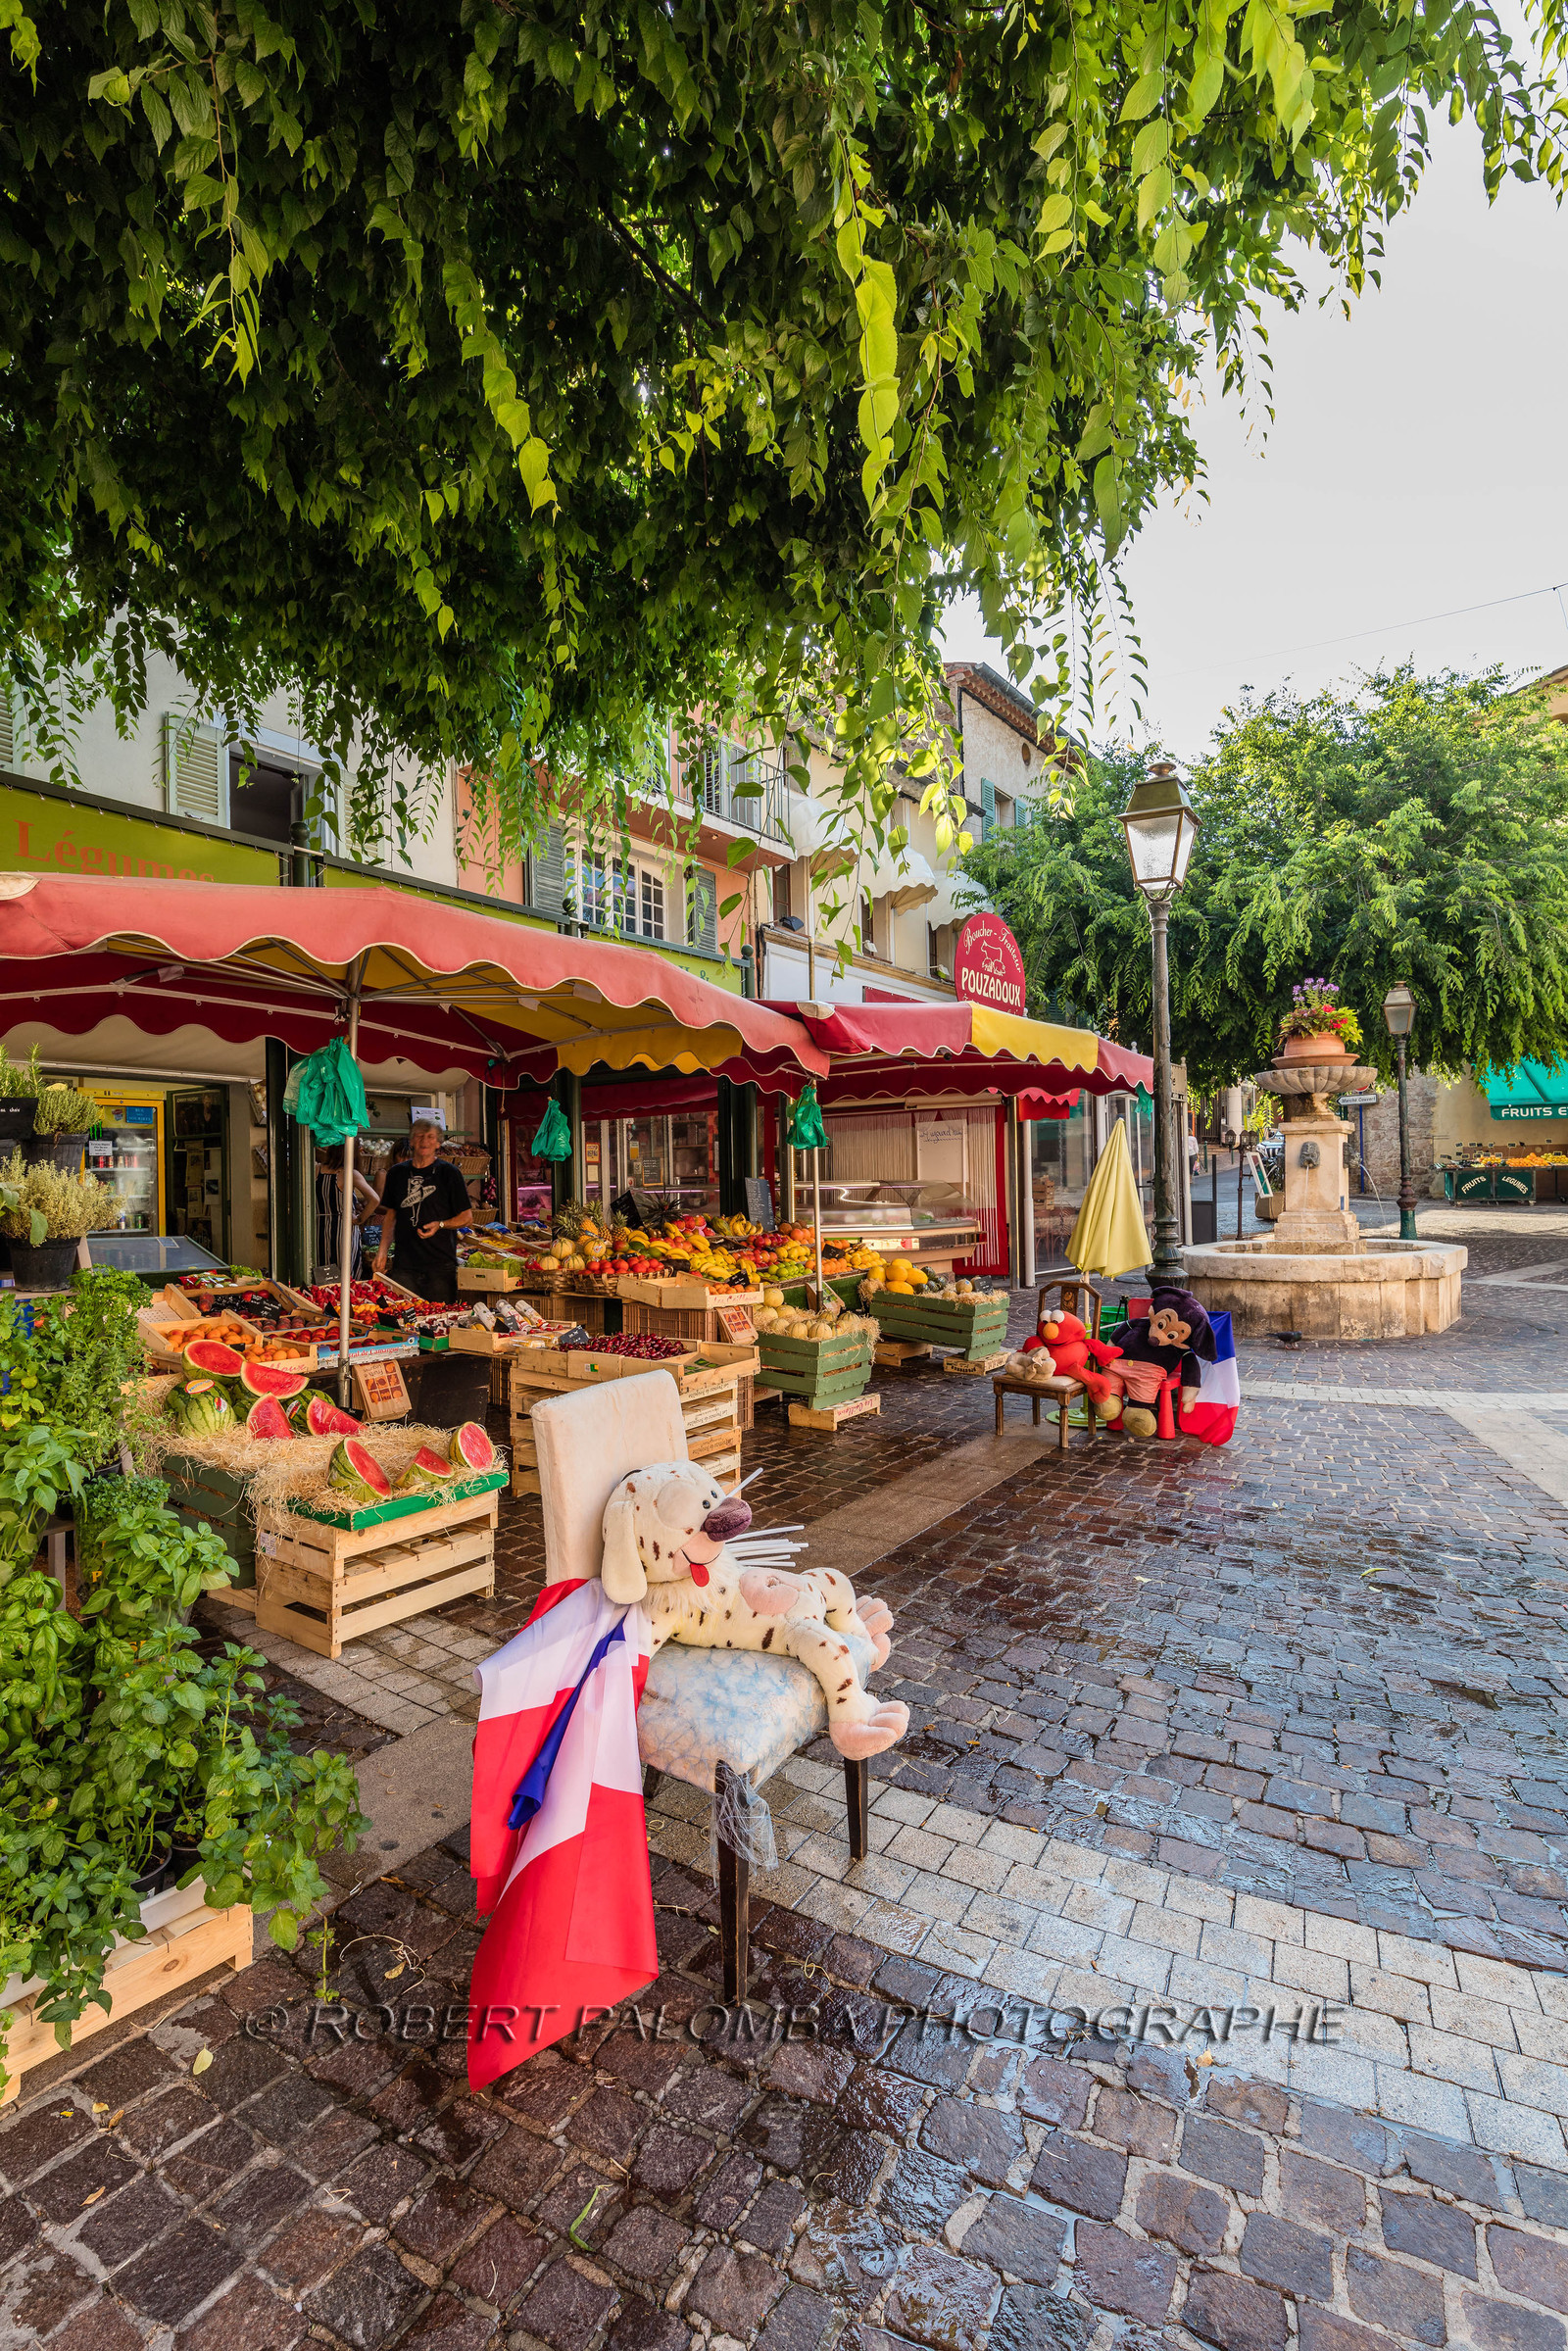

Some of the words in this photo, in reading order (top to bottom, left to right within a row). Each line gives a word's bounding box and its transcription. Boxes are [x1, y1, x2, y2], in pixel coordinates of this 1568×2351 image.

[963, 920, 993, 955] Boucher
[999, 927, 1021, 973] Traiteur
[961, 966, 1020, 1007] POUZADOUX
[1501, 1106, 1552, 1117] FRUITS
[1461, 1176, 1487, 1195] FRUITS
[1501, 1176, 1529, 1195] LEGUMES
